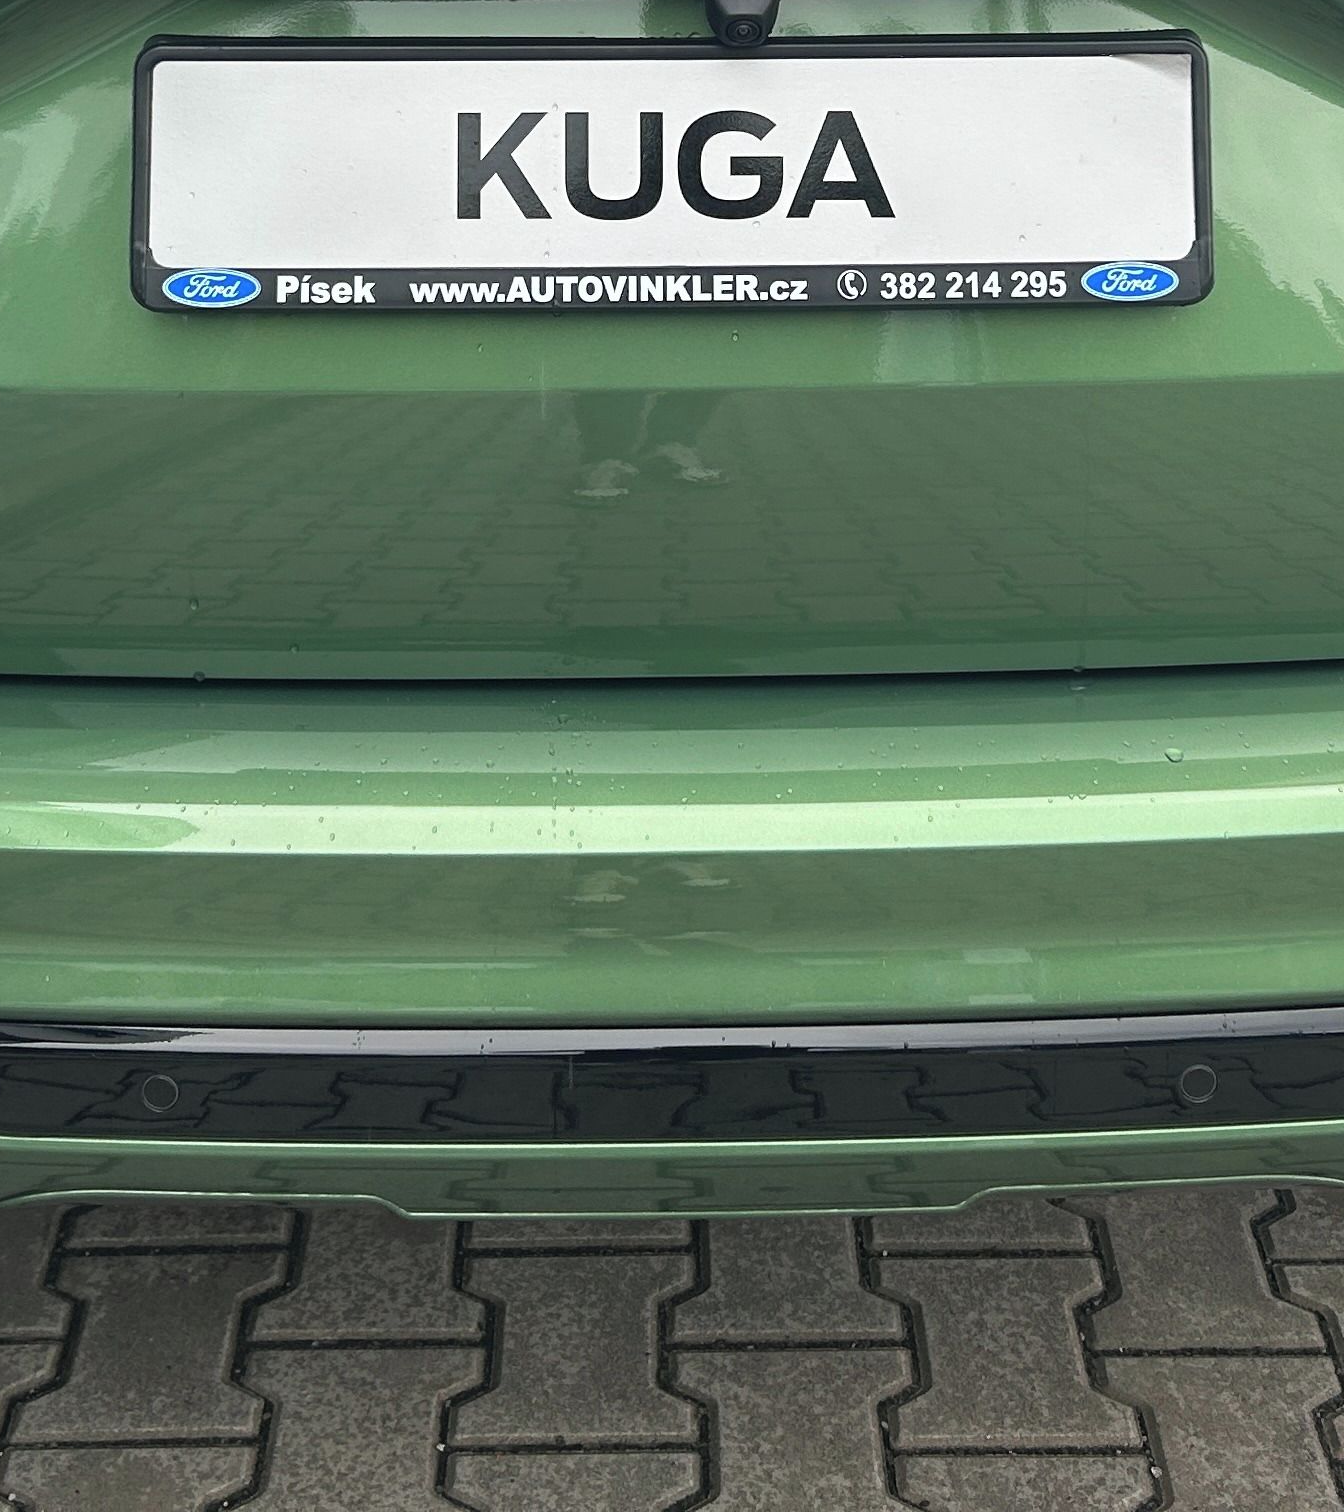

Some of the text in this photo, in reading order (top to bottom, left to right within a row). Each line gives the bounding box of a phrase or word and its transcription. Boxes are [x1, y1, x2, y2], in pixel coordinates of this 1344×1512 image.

[455, 109, 897, 222] KUGA
[183, 273, 240, 299] Ford
[276, 270, 1068, 304] Písek www.AUTOVINKLER.cz 382 214 295
[1101, 267, 1158, 294] Ford
